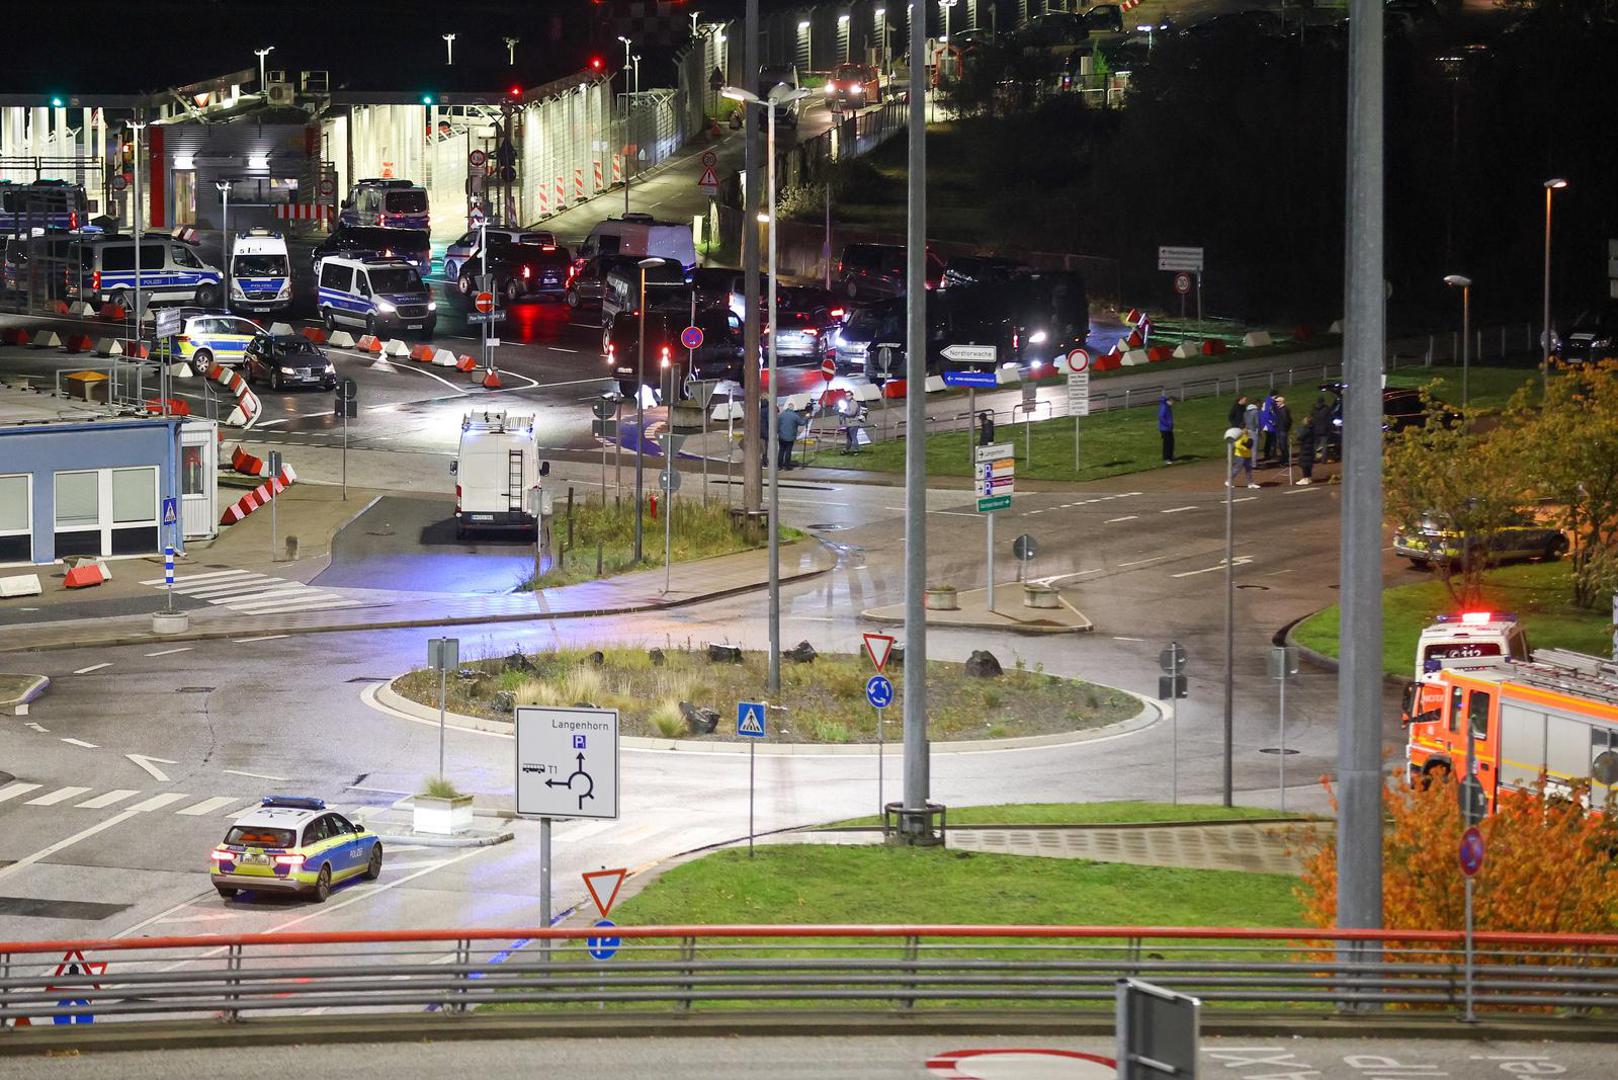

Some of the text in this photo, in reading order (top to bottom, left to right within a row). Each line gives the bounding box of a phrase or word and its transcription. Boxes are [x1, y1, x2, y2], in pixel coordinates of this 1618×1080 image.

[552, 720, 609, 731] Langenhorn
[548, 766, 558, 774] T1
[350, 847, 363, 859] POLIZEI
